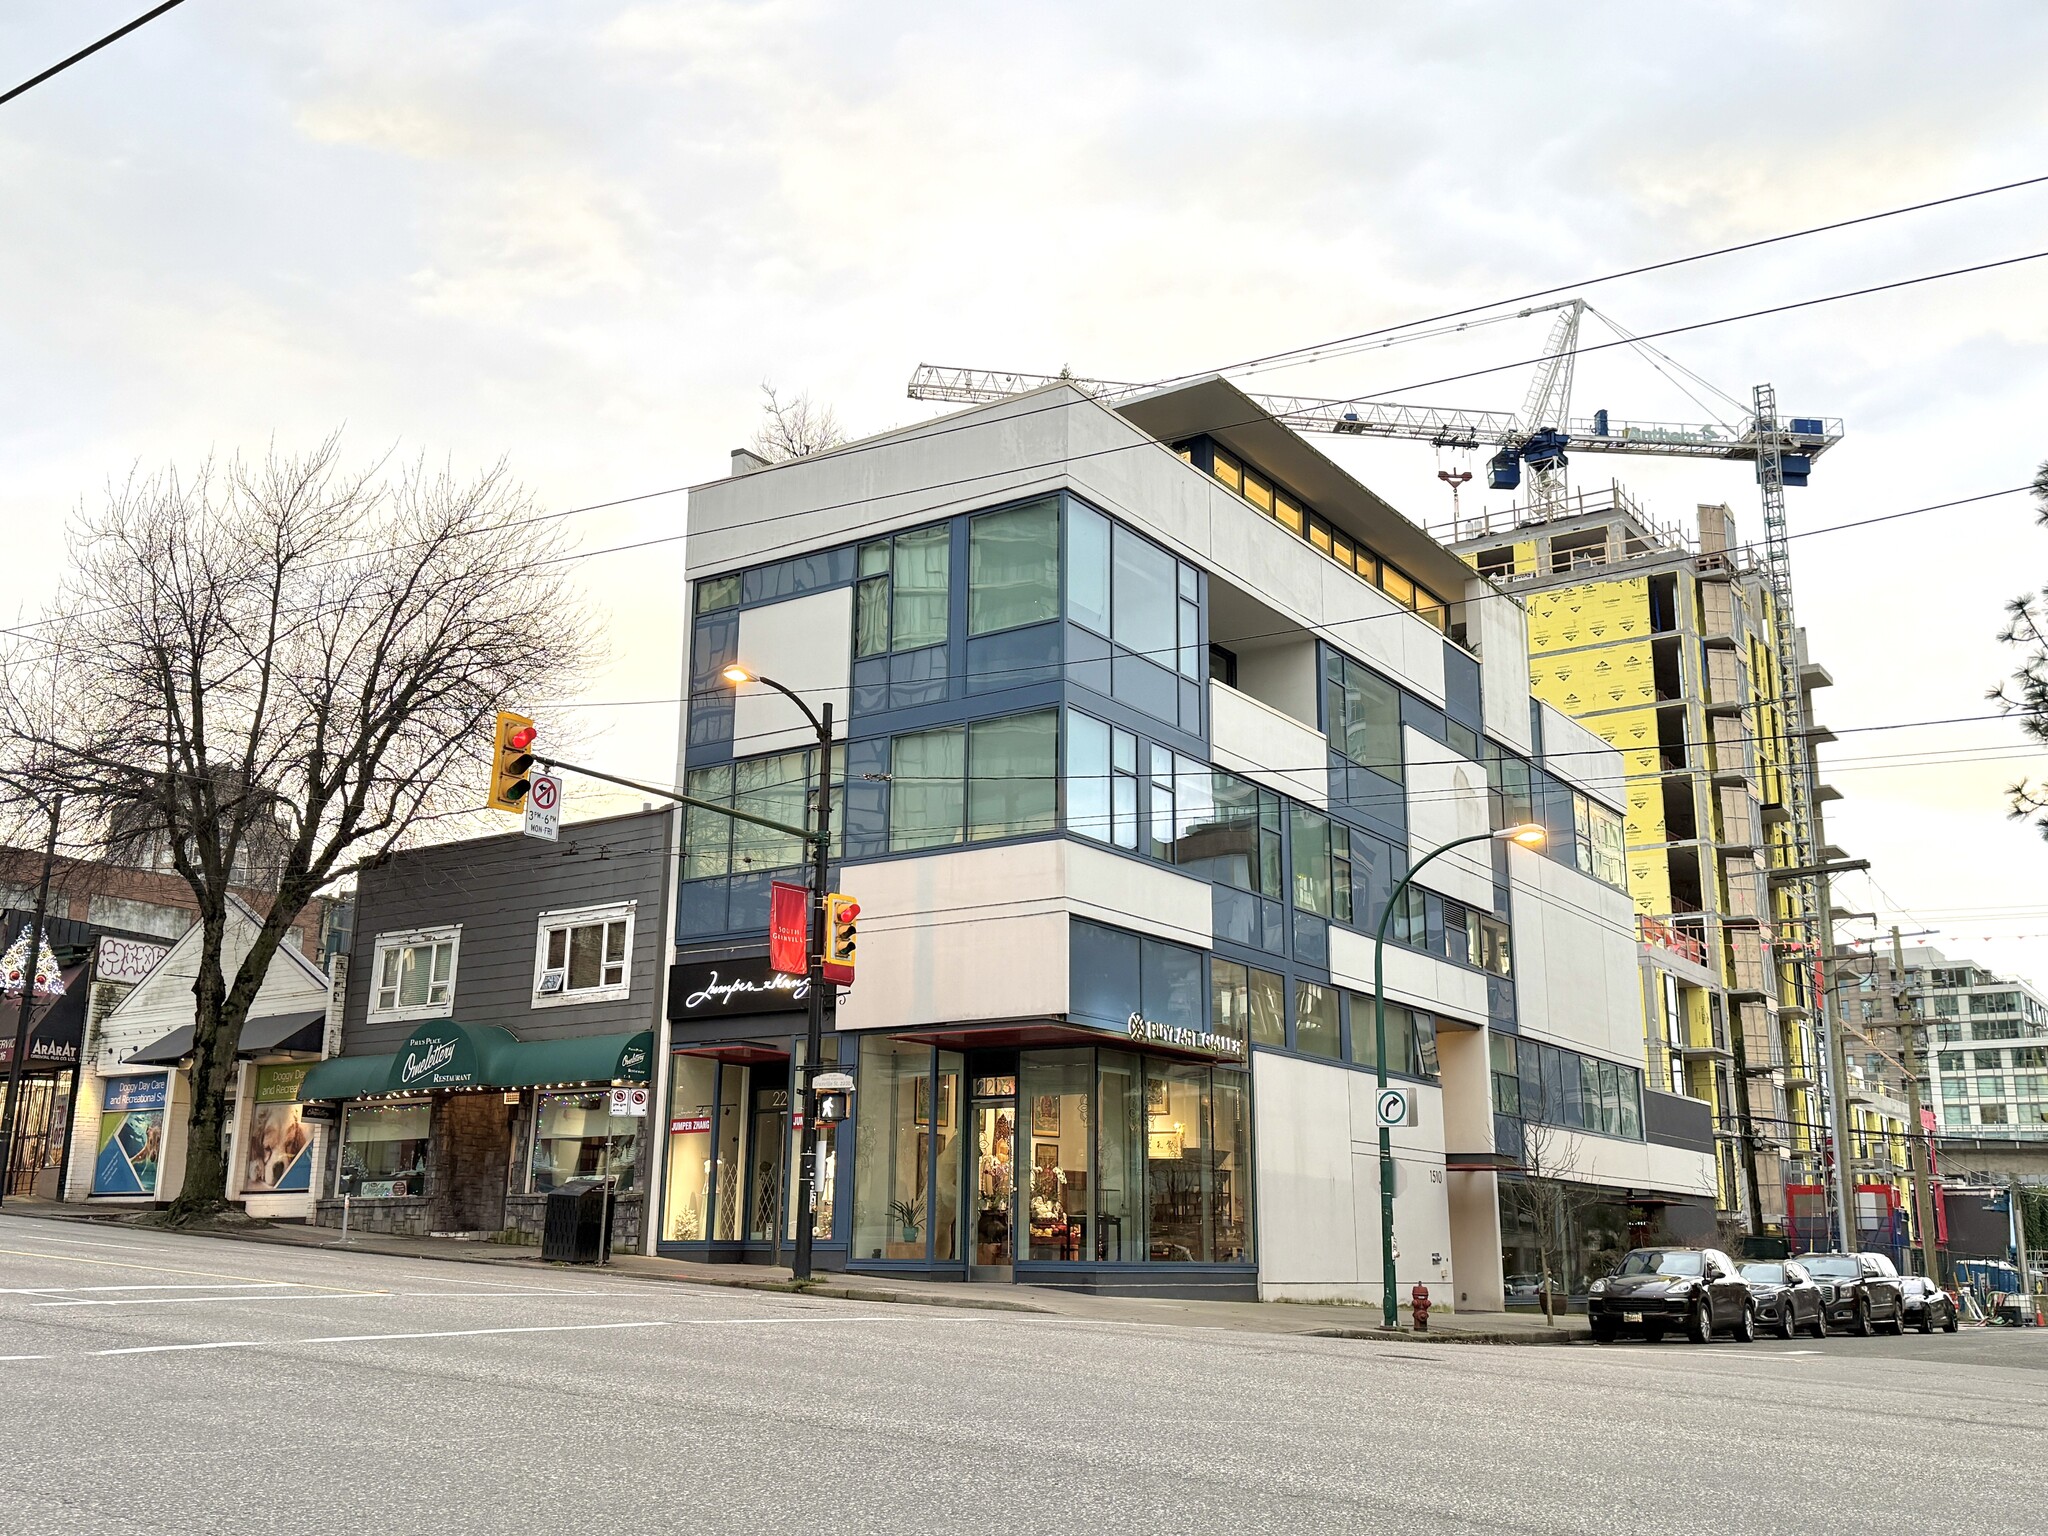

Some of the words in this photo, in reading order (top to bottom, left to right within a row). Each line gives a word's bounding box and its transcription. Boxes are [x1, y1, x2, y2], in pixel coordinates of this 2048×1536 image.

[402, 1042, 456, 1082] Omelettery
[273, 1072, 294, 1082] Doggy
[433, 1074, 472, 1082] RESTAURANT
[120, 1082, 138, 1094] Doggy
[138, 1081, 150, 1092] Day
[151, 1080, 165, 1090] Care
[262, 1085, 275, 1096] and
[110, 1096, 120, 1105] and
[122, 1092, 156, 1104] Recreational
[672, 1121, 692, 1131] JUMPER
[693, 1120, 710, 1130] ZHANG
[1430, 1170, 1442, 1184] 1510
